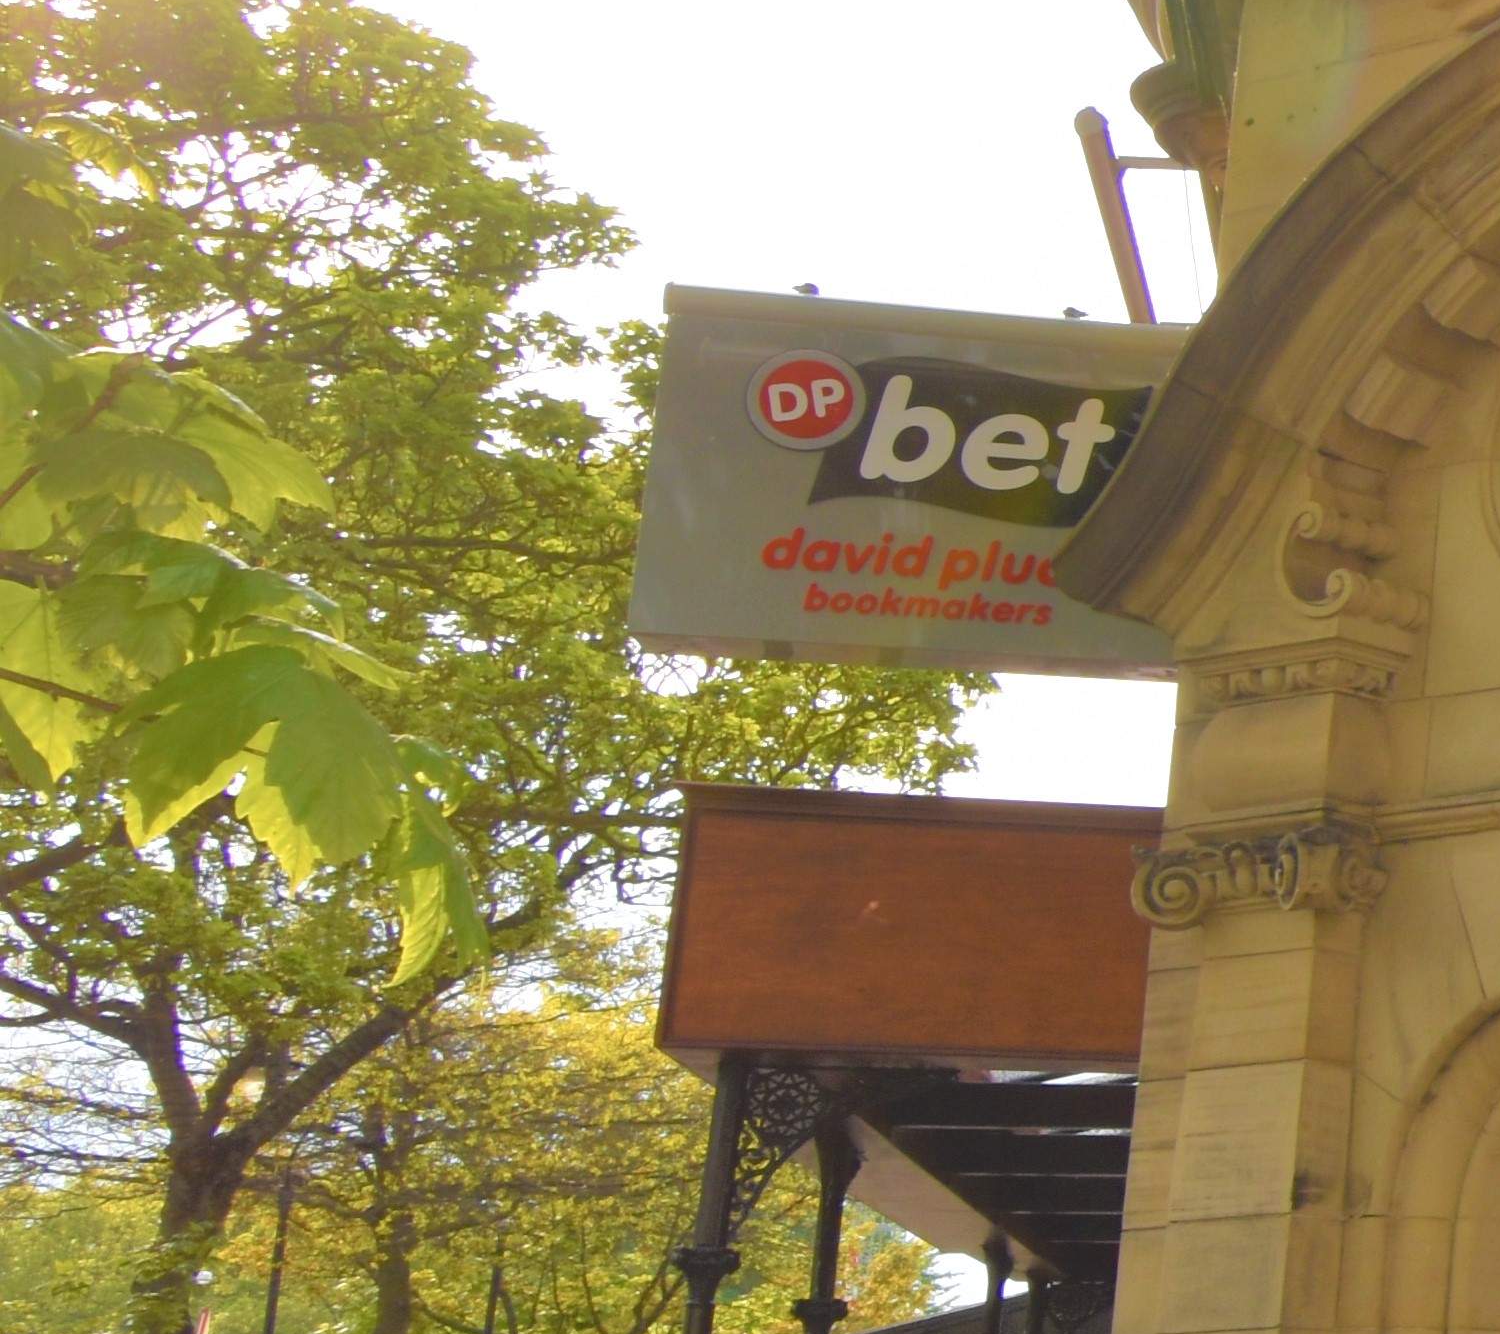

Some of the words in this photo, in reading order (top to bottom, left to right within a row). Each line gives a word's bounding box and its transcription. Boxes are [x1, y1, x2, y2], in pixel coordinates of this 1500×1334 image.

[766, 377, 846, 423] DP
[859, 373, 1116, 495] bet
[761, 526, 934, 579] david
[937, 539, 1059, 591] pluc
[802, 582, 1052, 627] bookmakers
